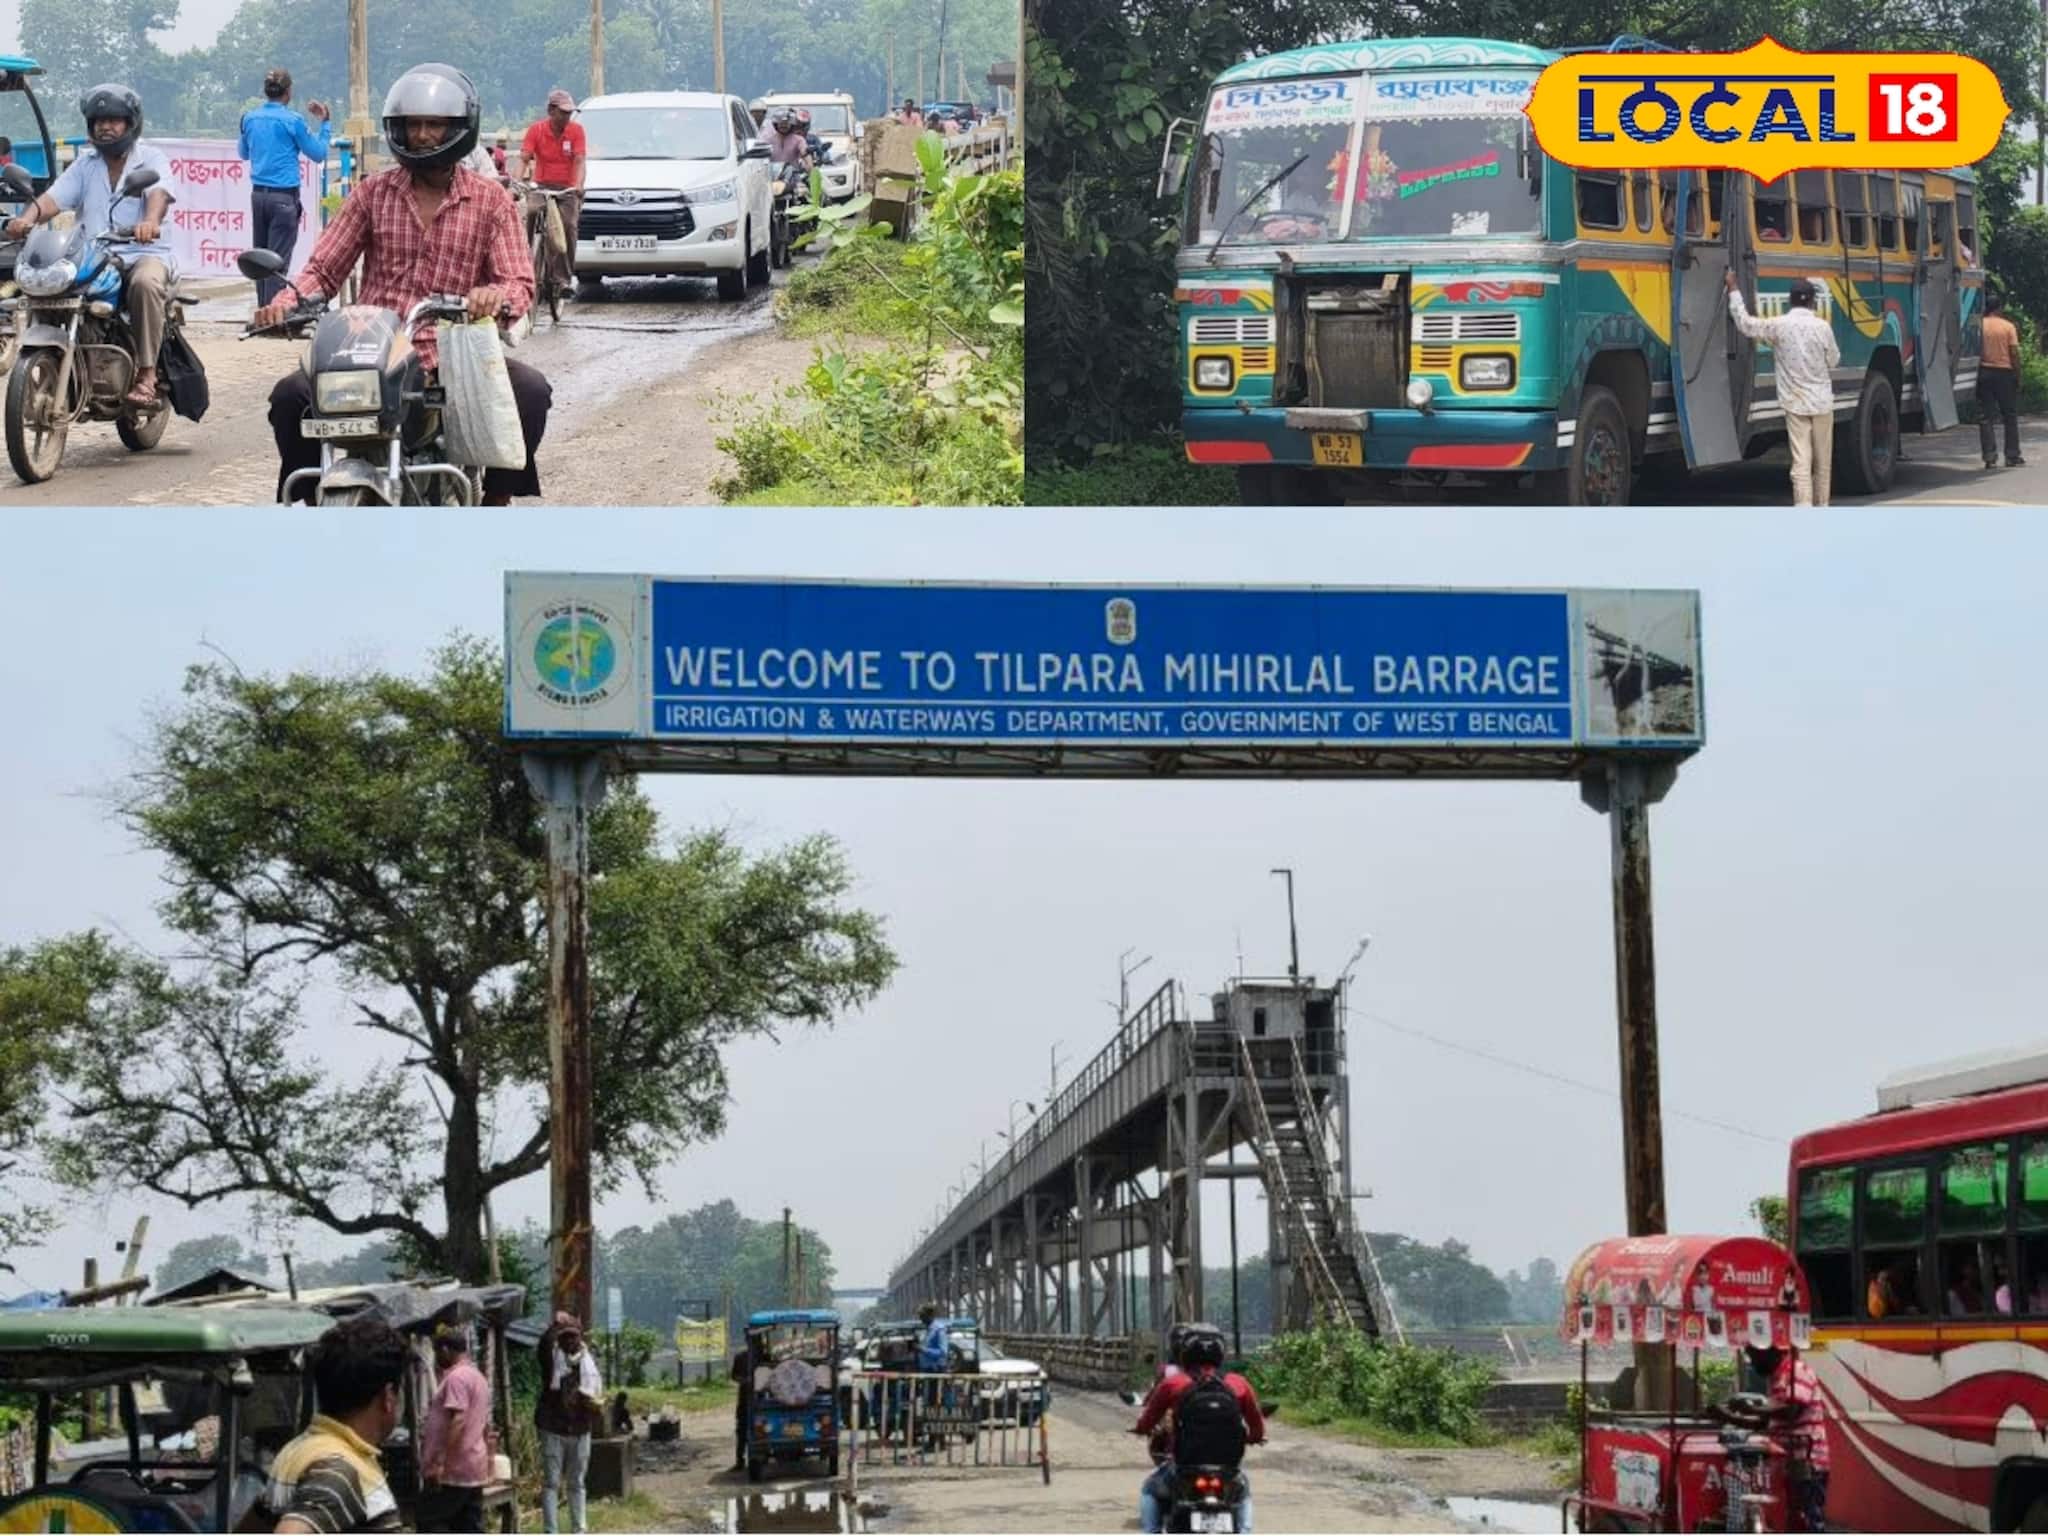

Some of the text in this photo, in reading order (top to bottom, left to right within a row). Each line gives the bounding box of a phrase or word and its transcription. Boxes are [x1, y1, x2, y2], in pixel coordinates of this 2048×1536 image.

[665, 646, 1560, 695] WELCOME TO TILPARA MIHIRLAL BARRAGE
[665, 704, 1560, 735] IRRIGATION & WATERWAYS DEPARTMENT, GOVERNMENT OF WEST BENGAL
